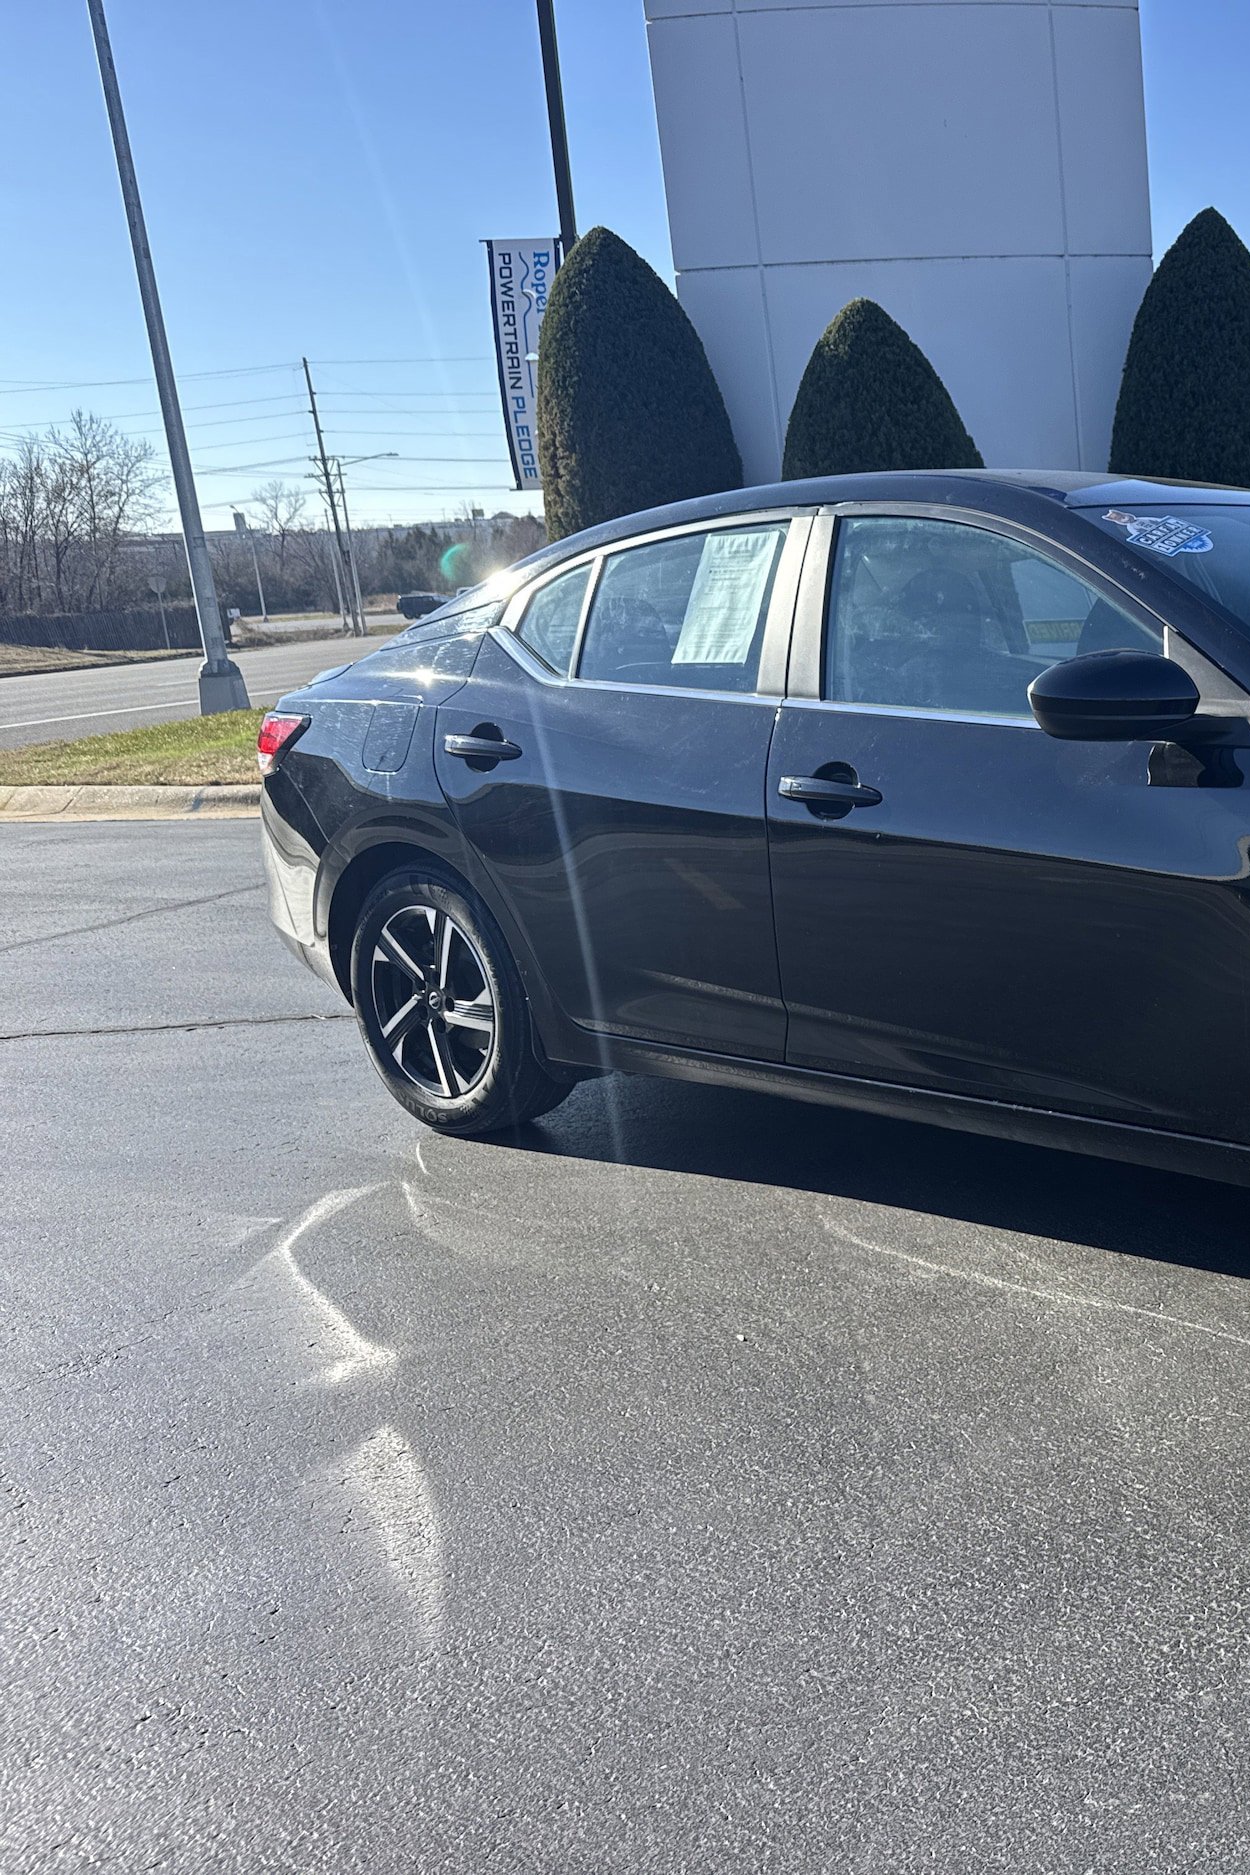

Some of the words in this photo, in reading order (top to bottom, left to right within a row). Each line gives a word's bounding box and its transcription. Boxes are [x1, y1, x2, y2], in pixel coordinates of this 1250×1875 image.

[498, 252, 523, 390] POWERTRAIN
[512, 395, 538, 480] PLEDGE
[1139, 518, 1186, 545] CARFAX
